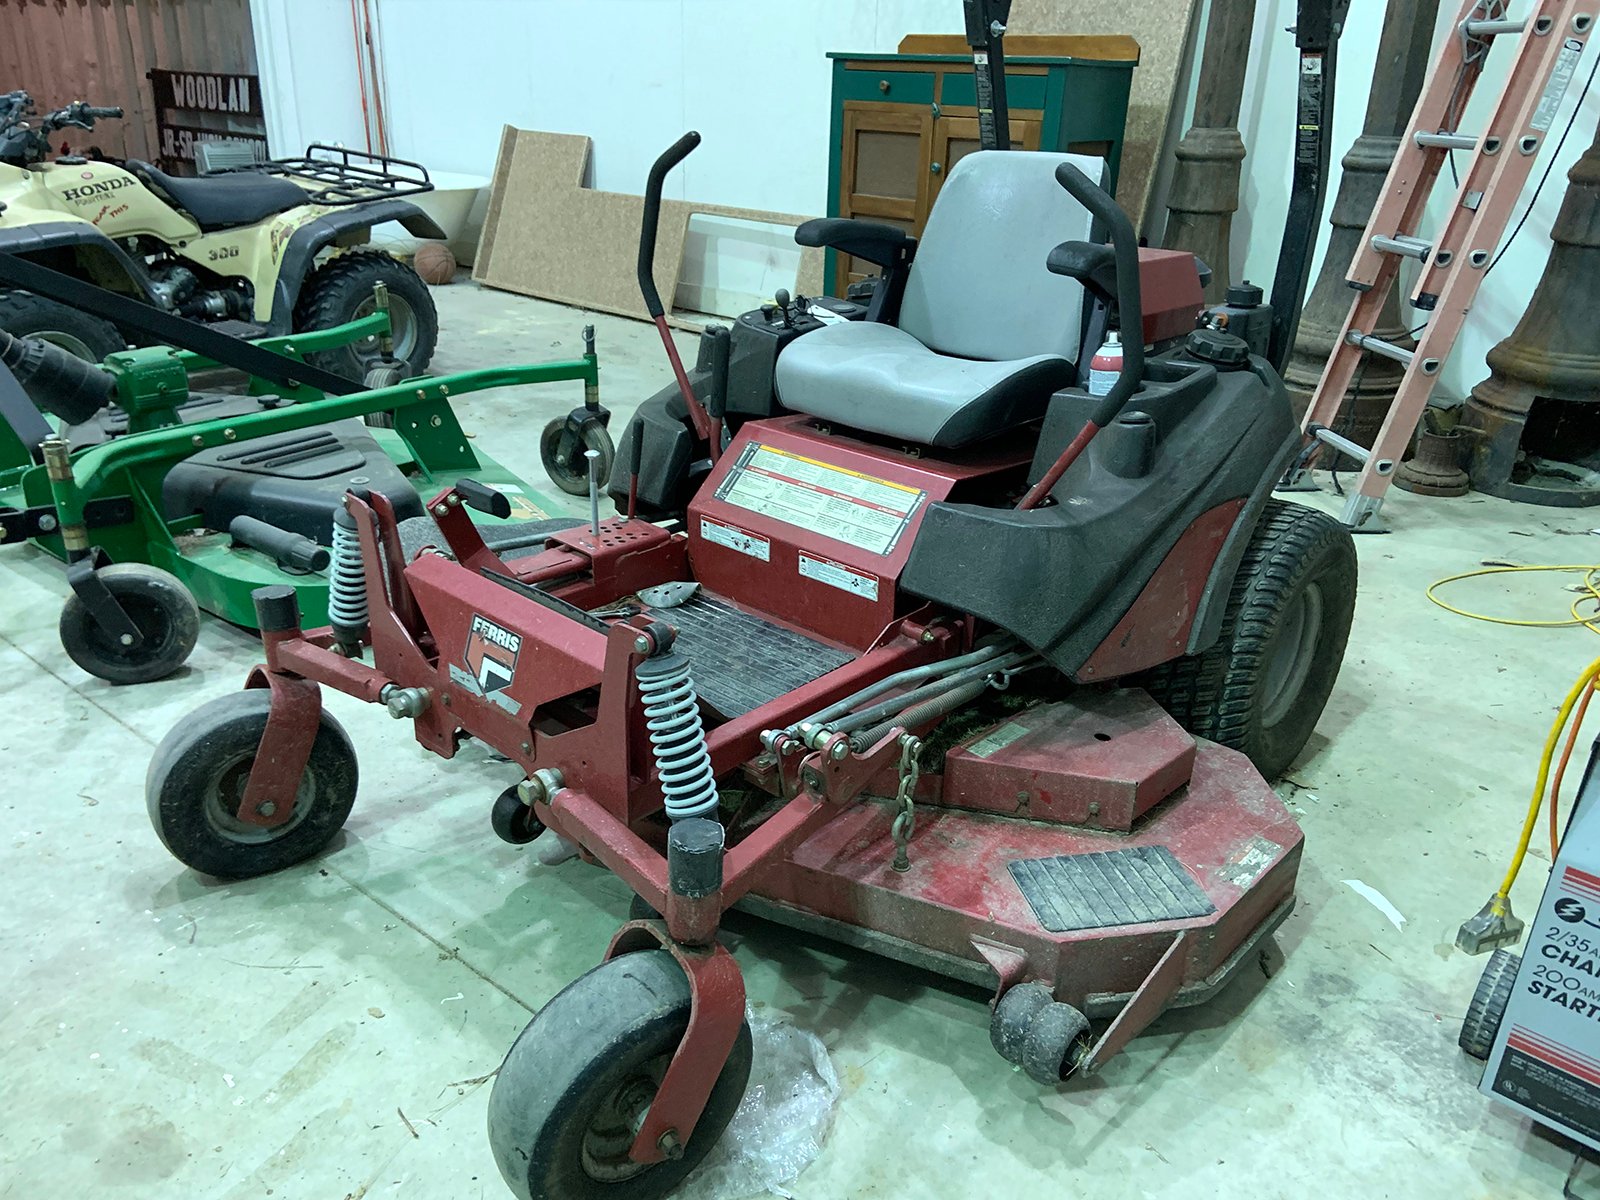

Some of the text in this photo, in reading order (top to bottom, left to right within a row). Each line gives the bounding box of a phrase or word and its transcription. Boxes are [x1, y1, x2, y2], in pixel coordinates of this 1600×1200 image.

[171, 73, 250, 113] WOODLAN
[62, 176, 136, 201] HONDA
[472, 616, 520, 653] FERRIS
[1527, 980, 1600, 1022] START
